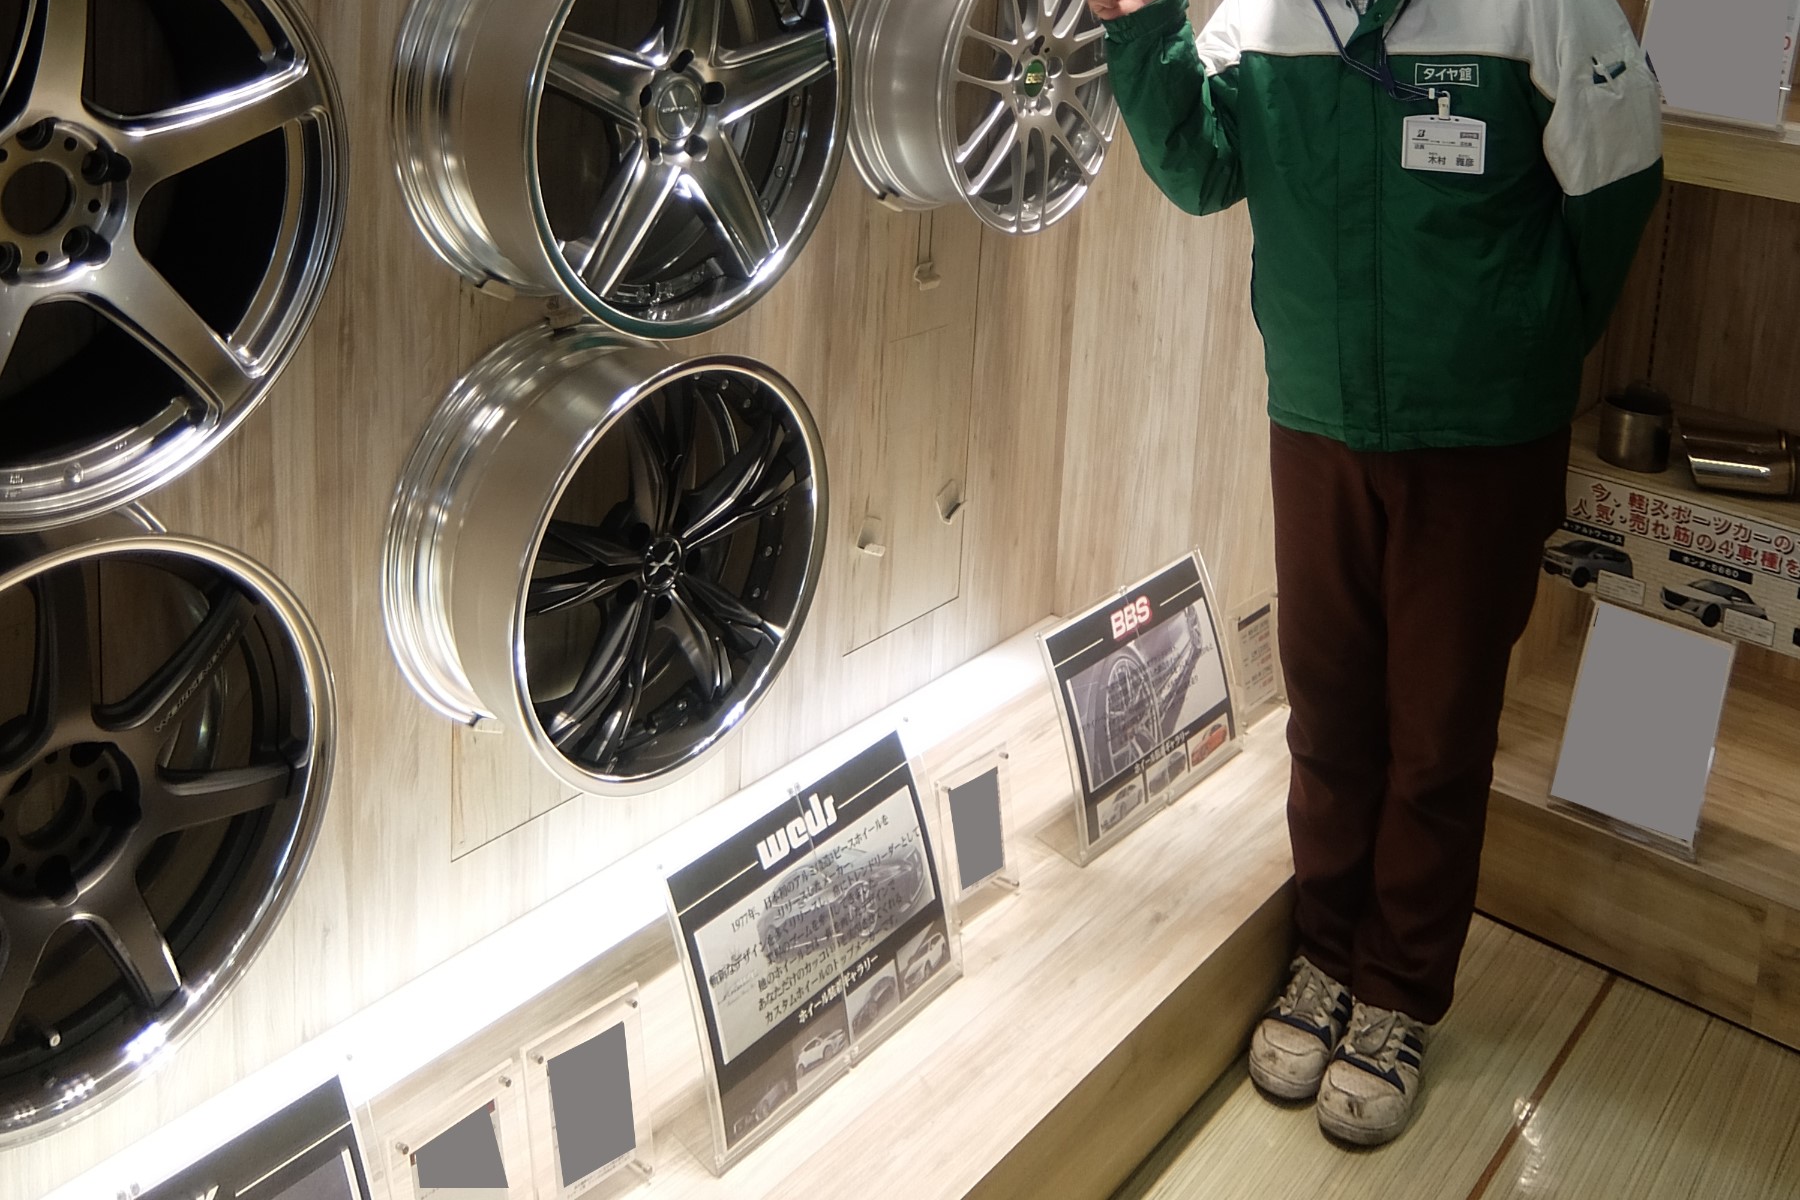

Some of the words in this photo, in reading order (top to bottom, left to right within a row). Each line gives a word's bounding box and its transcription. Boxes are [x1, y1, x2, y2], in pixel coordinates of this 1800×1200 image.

[1423, 67, 1472, 81] タイヤ館
[1591, 482, 1800, 554] 今、軽スポーツカーの
[1110, 596, 1153, 641] BBS
[756, 793, 839, 870] weds
